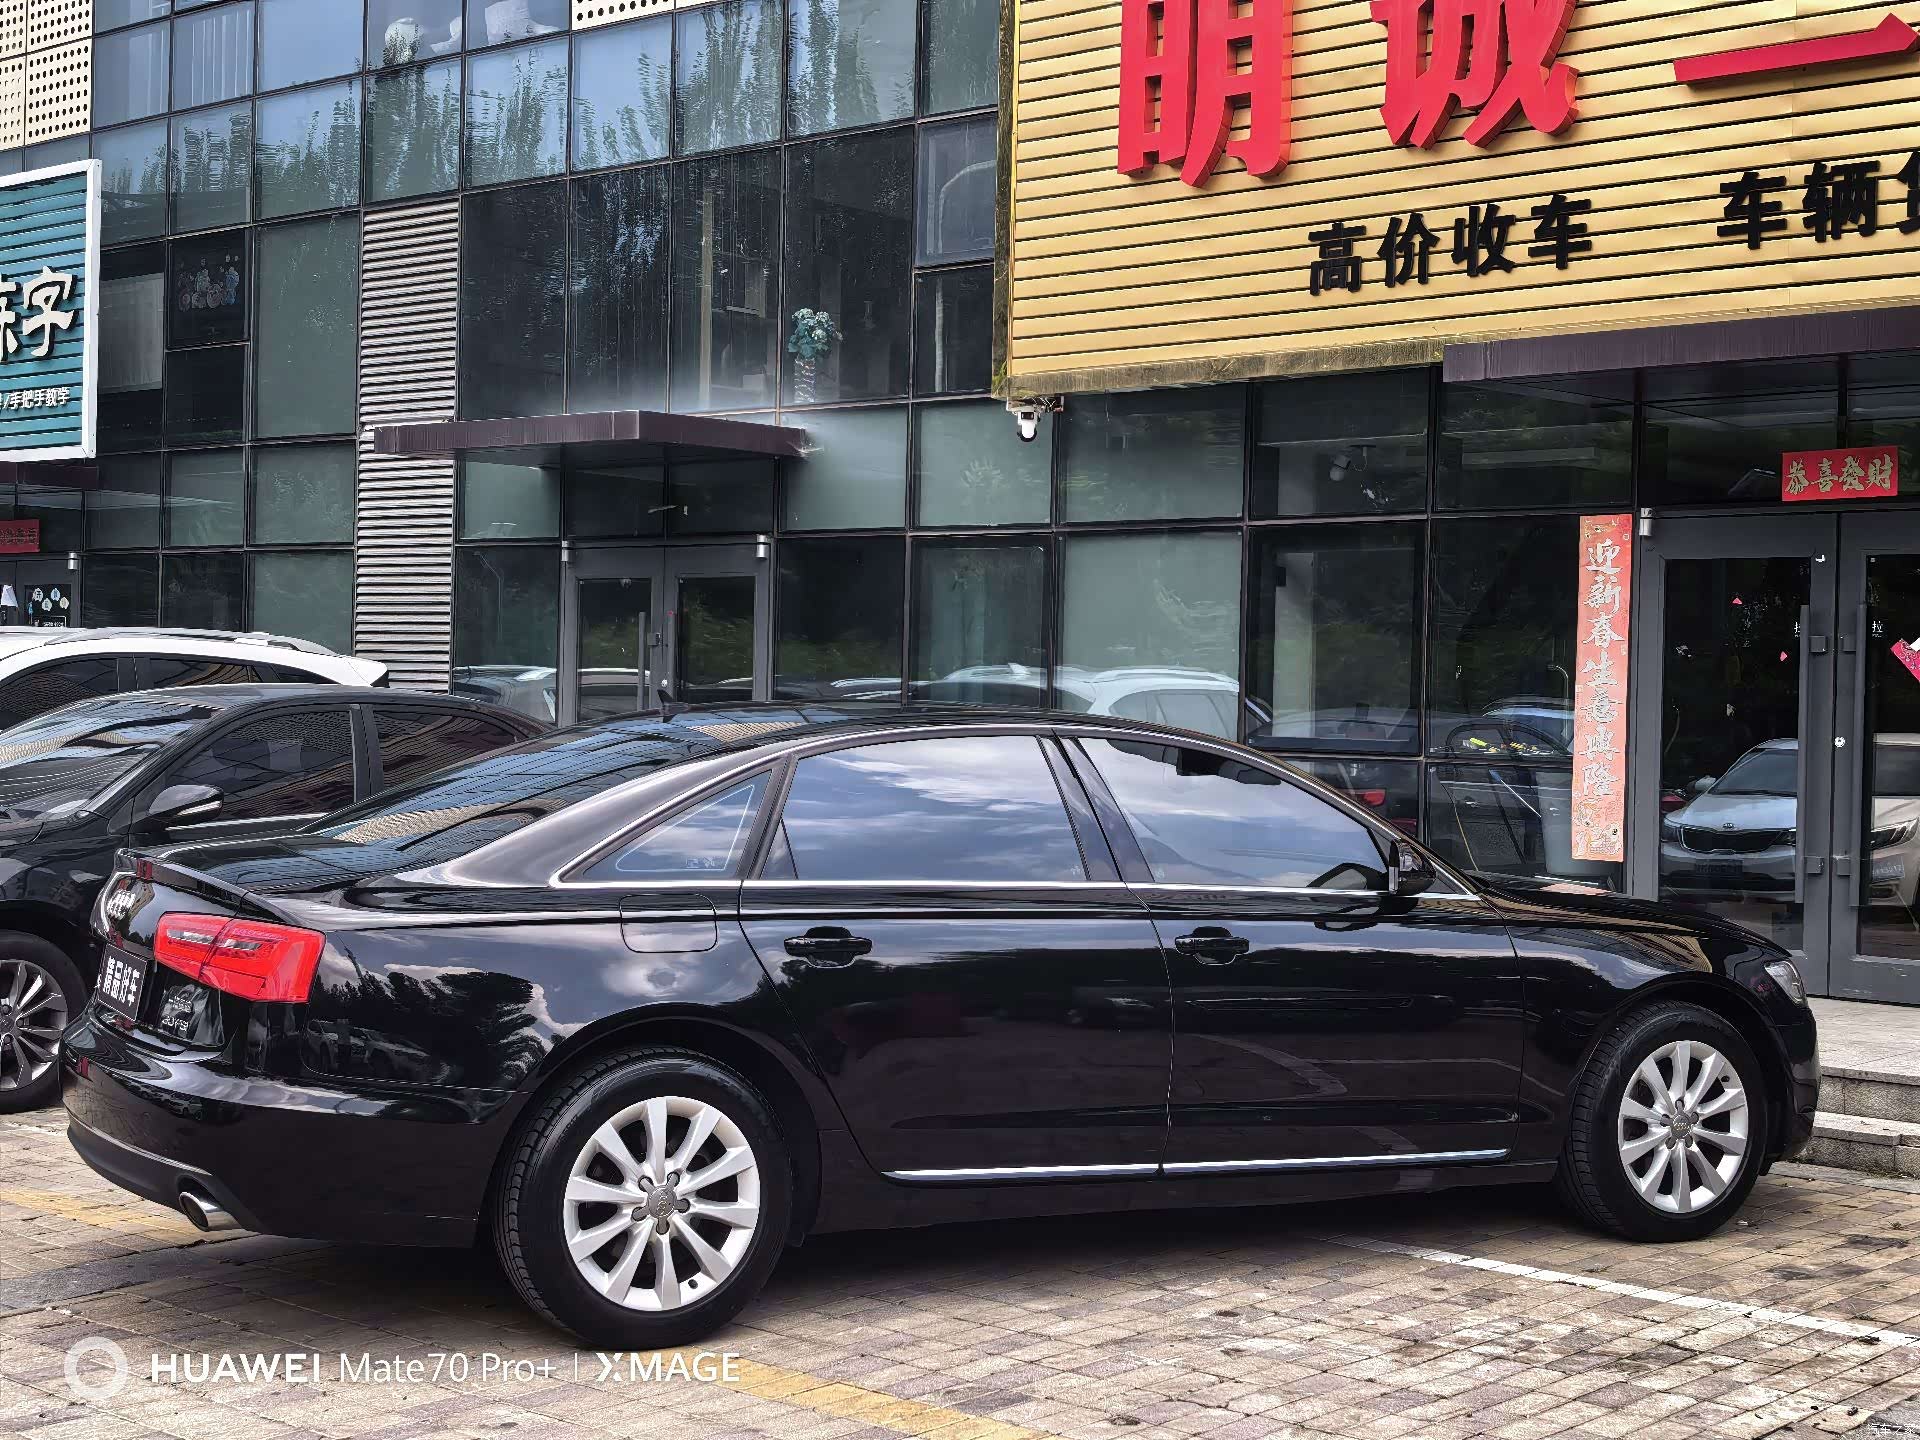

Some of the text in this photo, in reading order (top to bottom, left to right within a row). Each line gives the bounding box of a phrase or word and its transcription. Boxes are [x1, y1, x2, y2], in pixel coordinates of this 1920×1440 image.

[1308, 194, 1592, 296] 高价收车
[0, 387, 70, 410] /手把手教学
